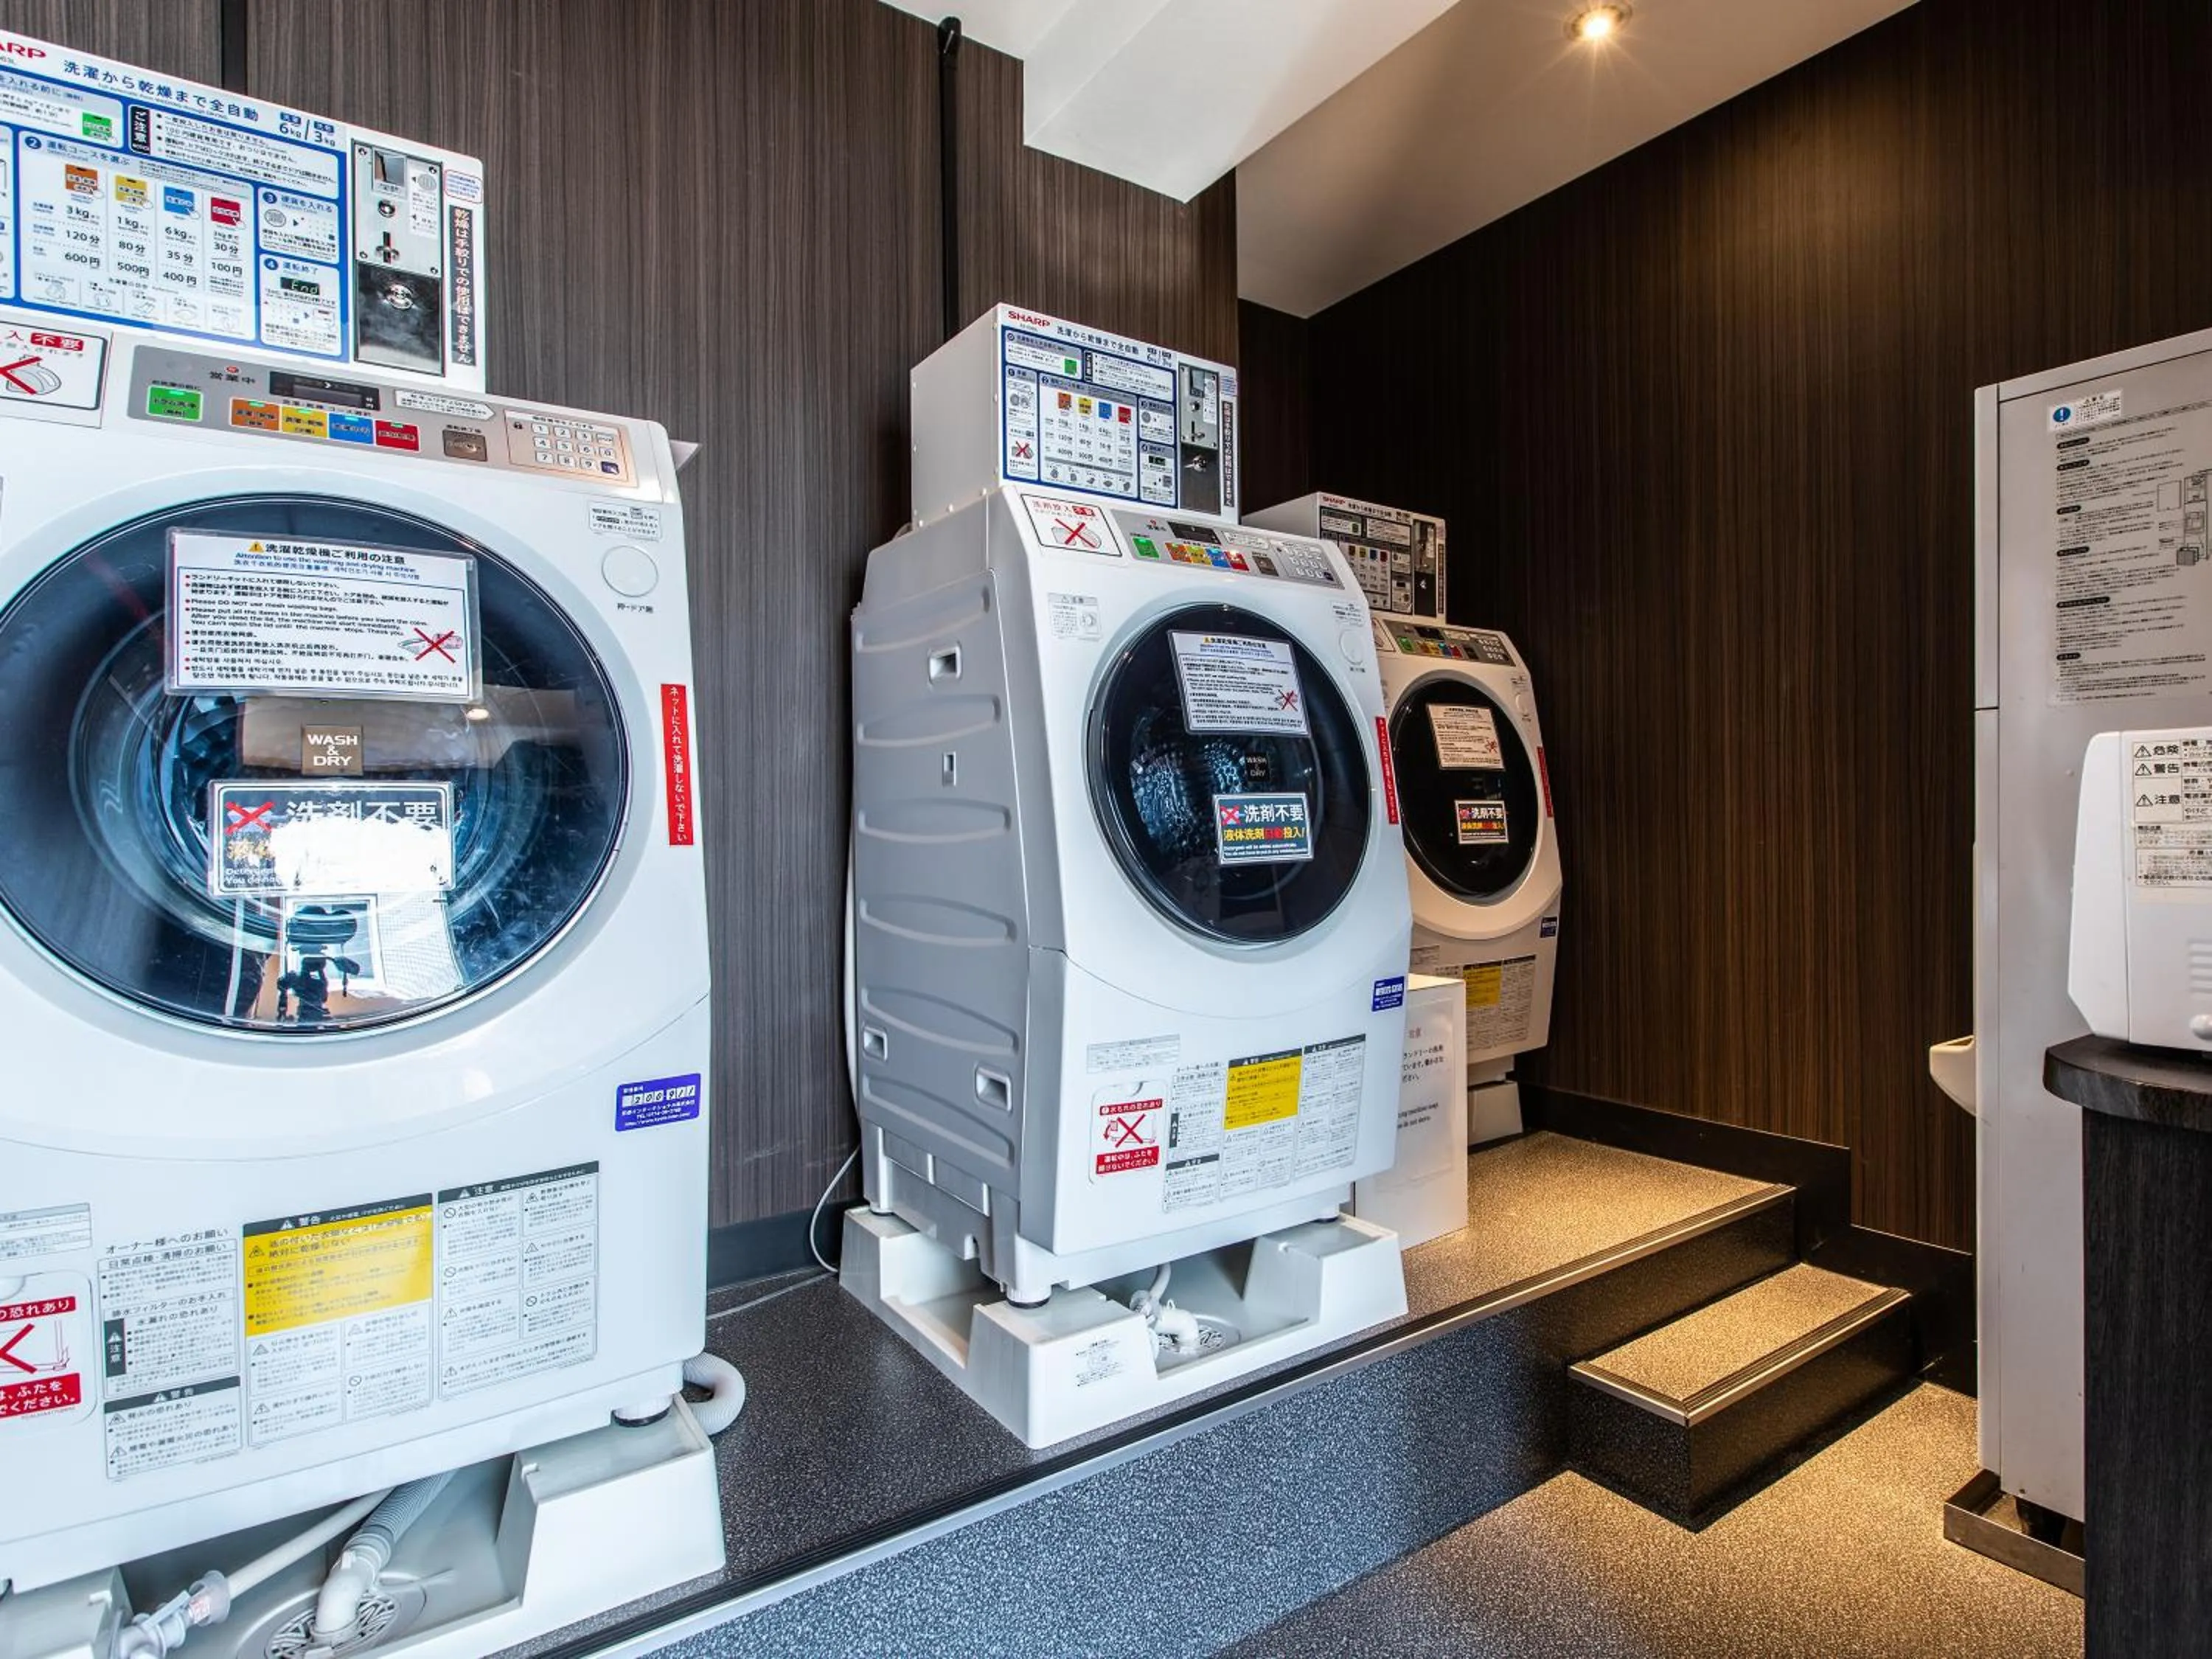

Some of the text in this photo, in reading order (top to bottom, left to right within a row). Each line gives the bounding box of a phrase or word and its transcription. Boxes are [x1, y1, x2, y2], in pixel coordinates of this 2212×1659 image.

[0, 74, 61, 97] 入れる前に
[63, 60, 258, 122] 洗濯から乾燥まで全自動
[1008, 310, 1051, 327] SHARP
[266, 544, 406, 564] 洗濯乾燥機ご利用の注意
[307, 734, 358, 745] WASH
[326, 745, 339, 757] &
[2154, 745, 2179, 756] 危険
[313, 756, 352, 767] DRY
[2154, 763, 2180, 773] 警告
[2155, 794, 2180, 804] 注意
[1244, 804, 1304, 824] 洗剤不要
